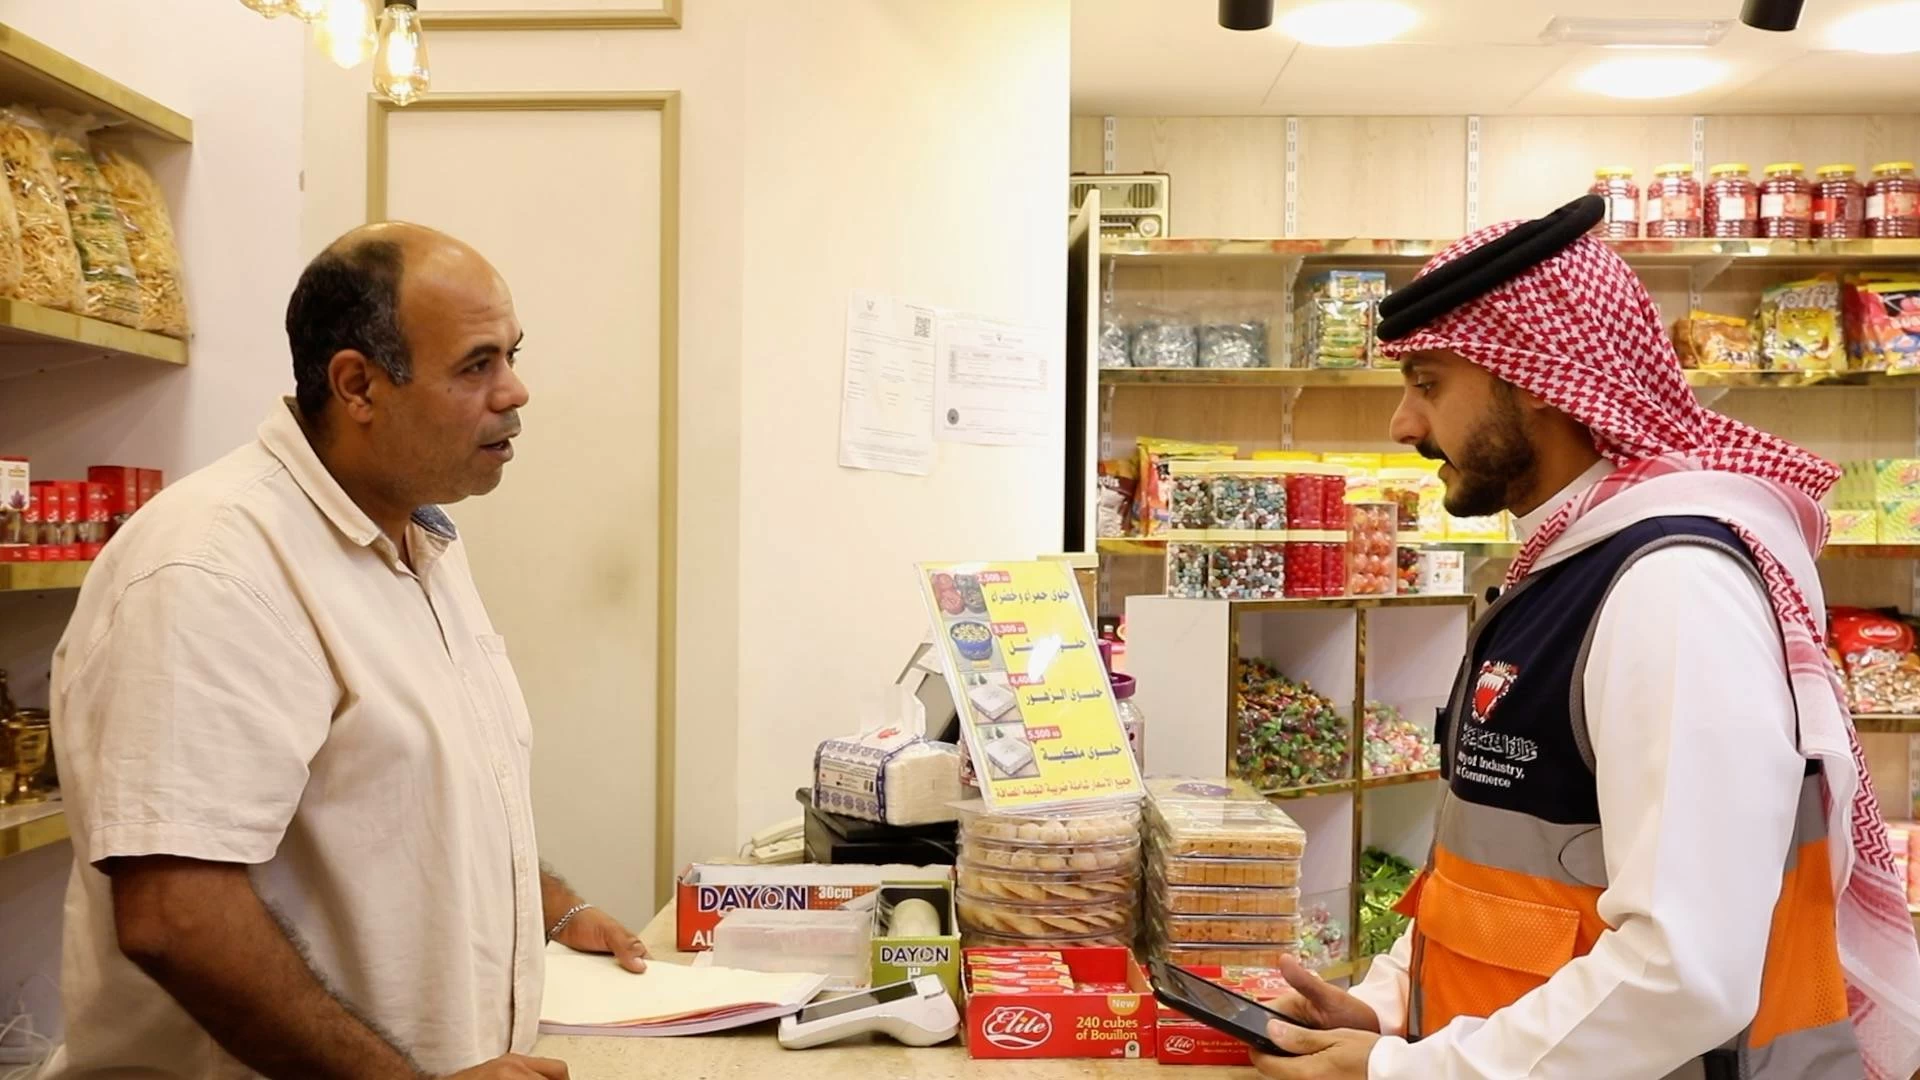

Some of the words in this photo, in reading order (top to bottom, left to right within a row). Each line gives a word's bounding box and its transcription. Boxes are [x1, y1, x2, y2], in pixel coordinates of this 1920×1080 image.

[1026, 688, 1067, 705] الزهور
[1071, 685, 1103, 702] حلوى
[1040, 746, 1085, 765] ملكية
[1088, 744, 1122, 761] حلوى
[1479, 755, 1525, 780] Industry,
[1461, 766, 1511, 788] Commerce
[698, 885, 808, 911] DAYON
[817, 886, 854, 900] 30cm
[880, 946, 950, 963] DAYON
[1112, 999, 1136, 1009] New
[987, 1010, 1048, 1034] Elite
[1076, 1016, 1100, 1028] 240
[1103, 1016, 1138, 1029] cubes
[1075, 1029, 1089, 1041] of
[1091, 1029, 1138, 1041] Bouillon
